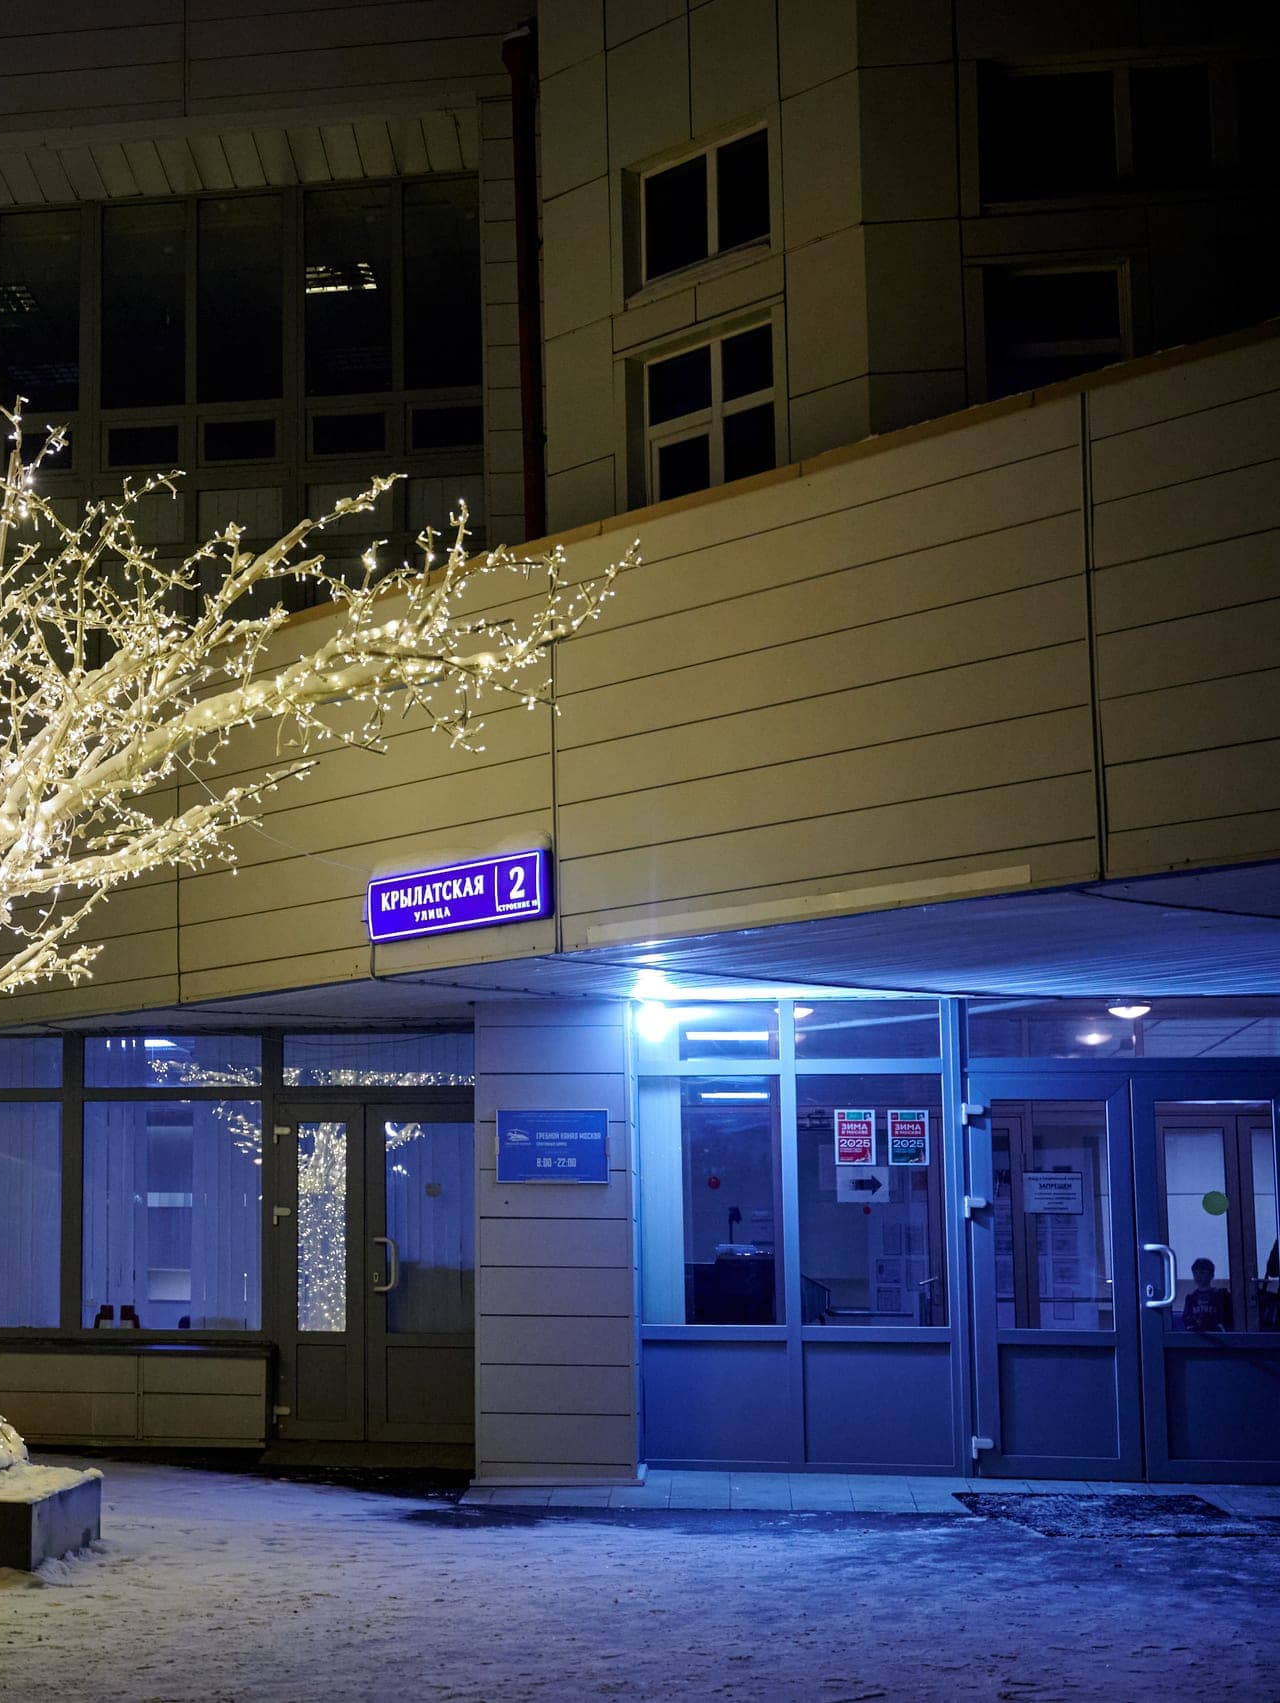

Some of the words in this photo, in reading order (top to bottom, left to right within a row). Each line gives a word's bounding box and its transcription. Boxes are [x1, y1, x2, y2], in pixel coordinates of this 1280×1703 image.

[509, 866, 525, 900] 2
[381, 875, 485, 912] КРЫЛАТСКАЯ
[414, 907, 451, 922] УЛИЦА
[839, 1138, 871, 1148] 2025
[892, 1139, 924, 1148] 2025
